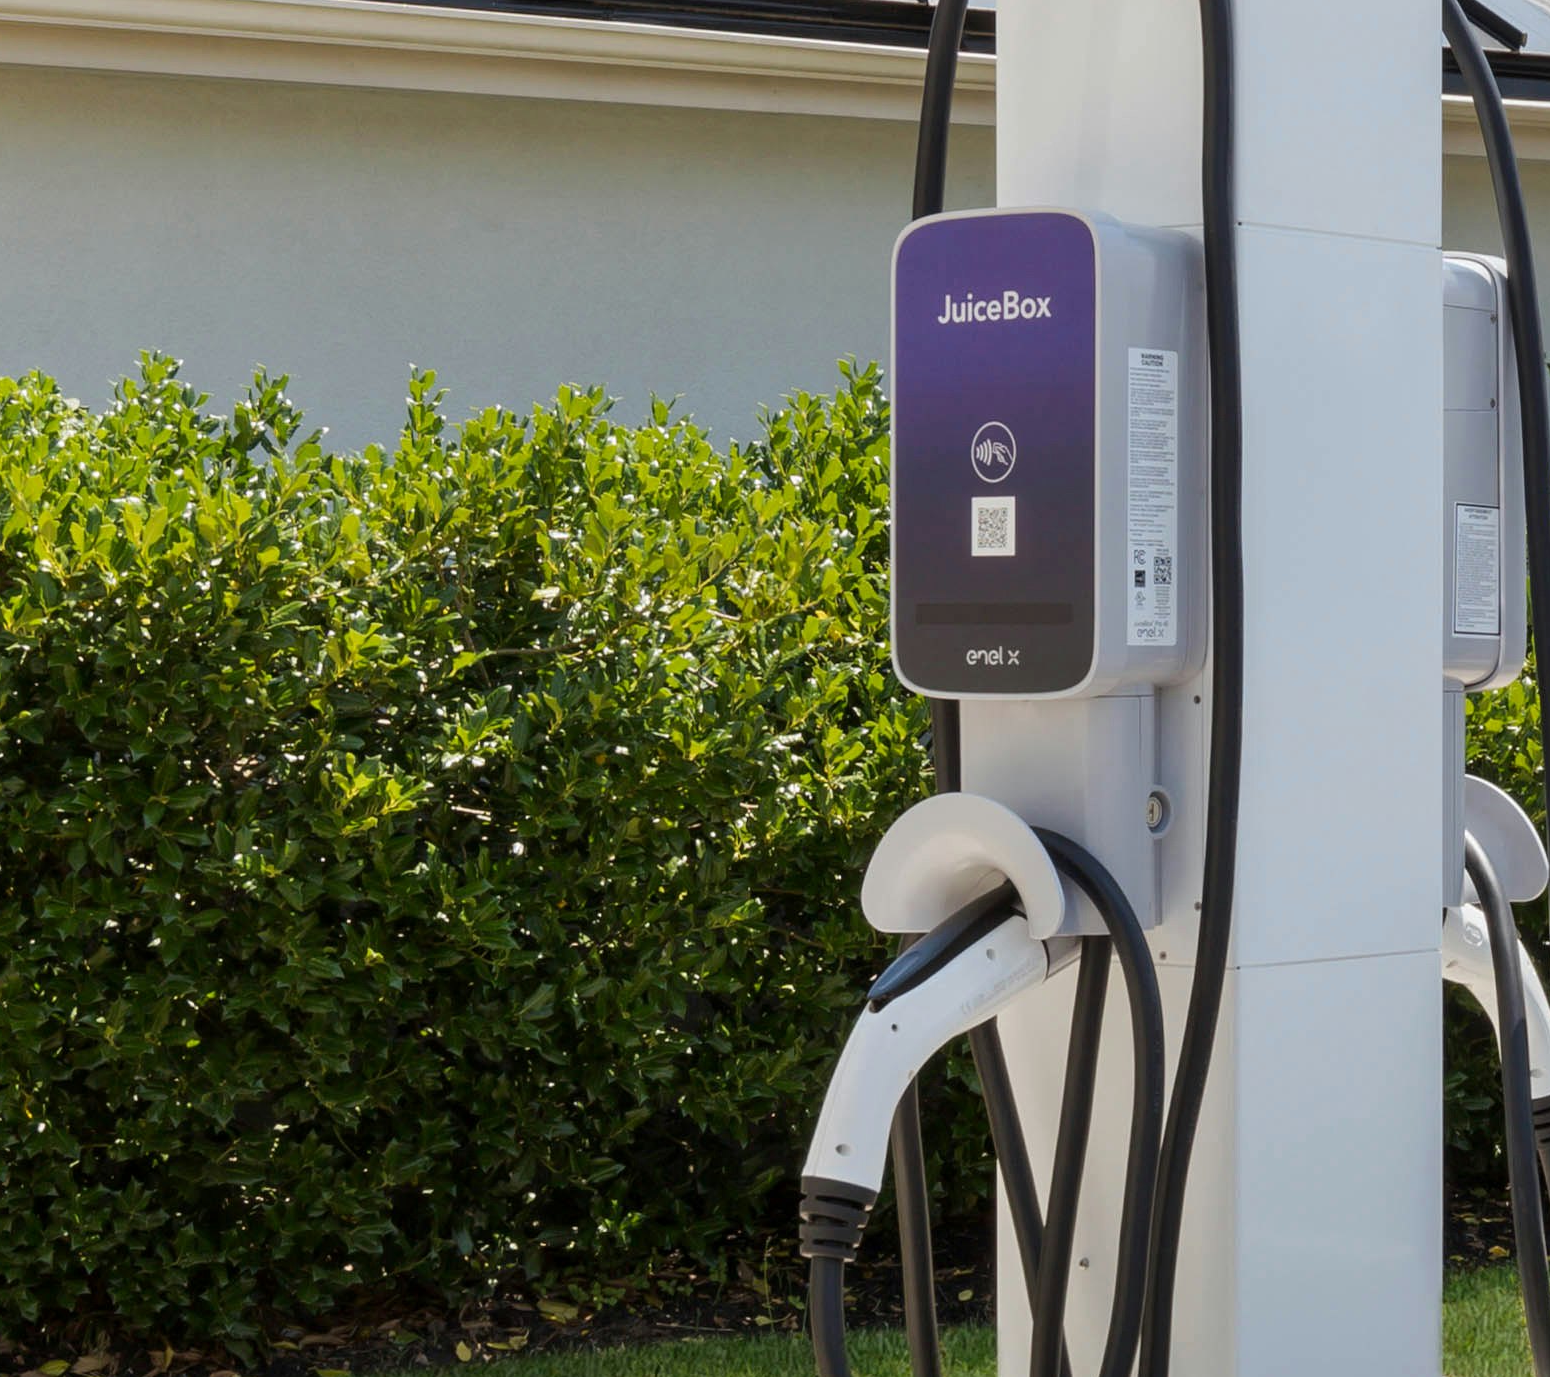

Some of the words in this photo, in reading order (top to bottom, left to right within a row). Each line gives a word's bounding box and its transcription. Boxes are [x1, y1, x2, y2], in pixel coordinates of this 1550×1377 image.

[937, 290, 1052, 324] JuiceBox
[966, 645, 1003, 665] enel
[1007, 649, 1020, 665] x
